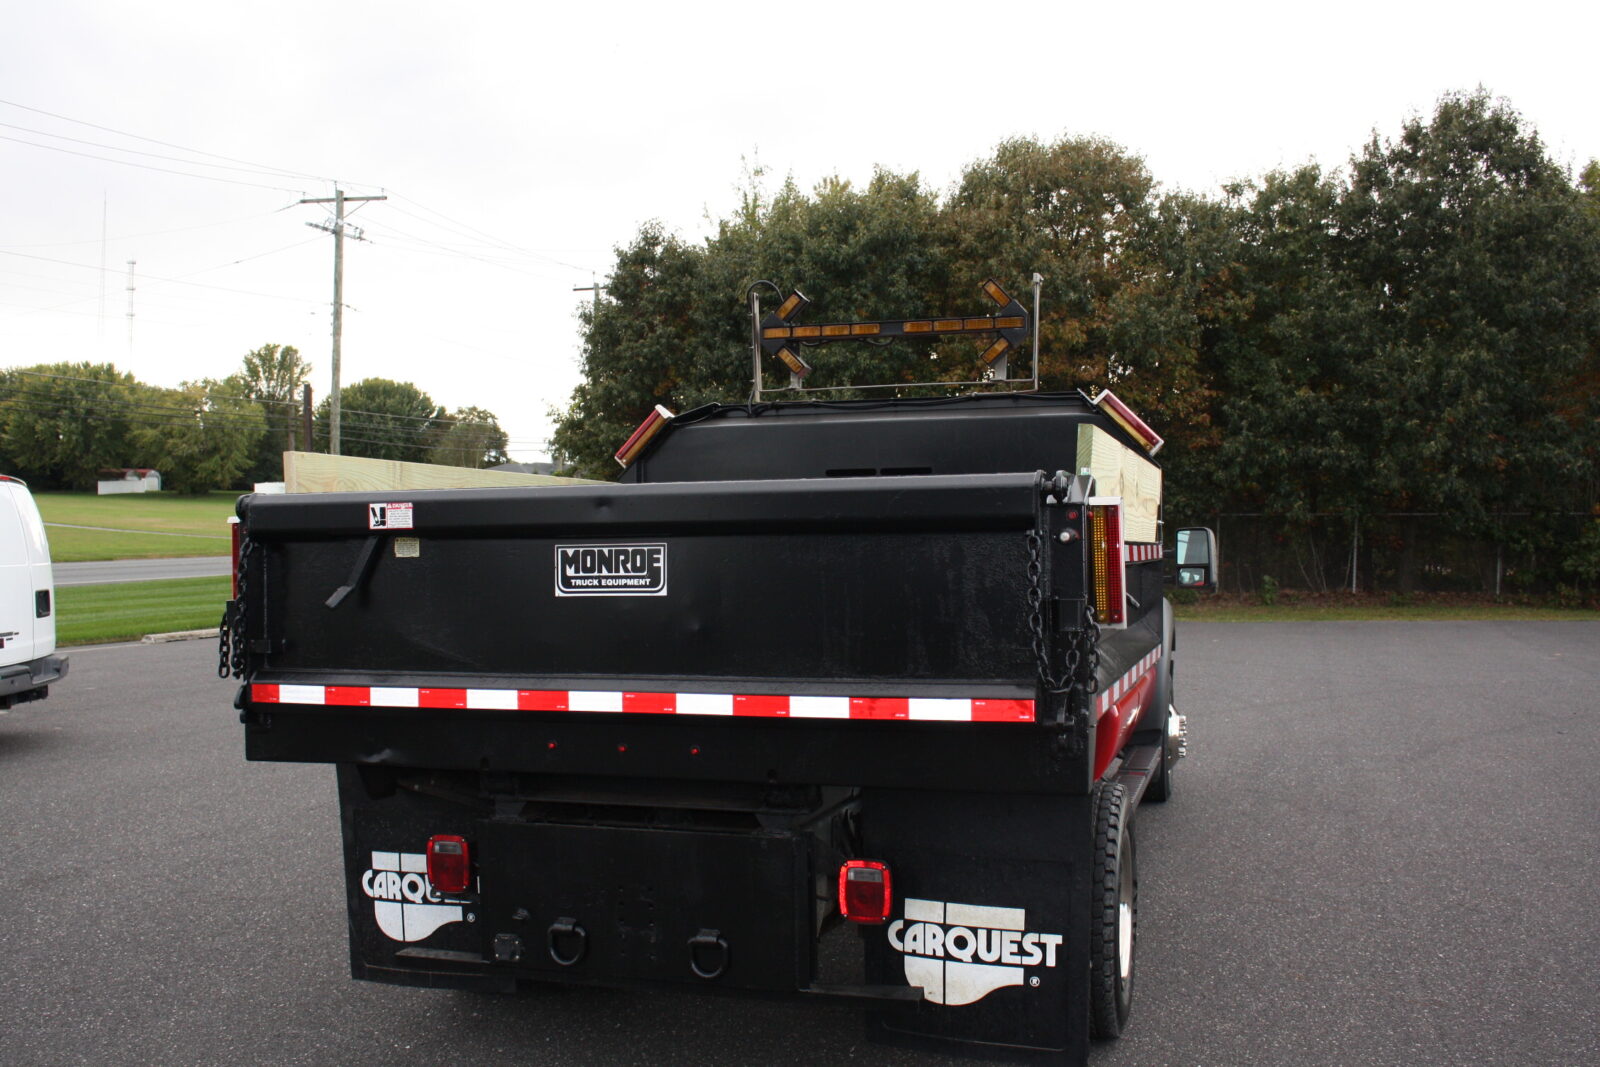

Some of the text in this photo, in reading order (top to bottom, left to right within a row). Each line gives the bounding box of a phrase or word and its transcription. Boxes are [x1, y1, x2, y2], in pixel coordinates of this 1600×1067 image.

[559, 548, 662, 575] MONROE
[601, 578, 651, 586] EQUIPMENT
[361, 869, 481, 904] CARQU
[887, 919, 1063, 968] CARQUEST
